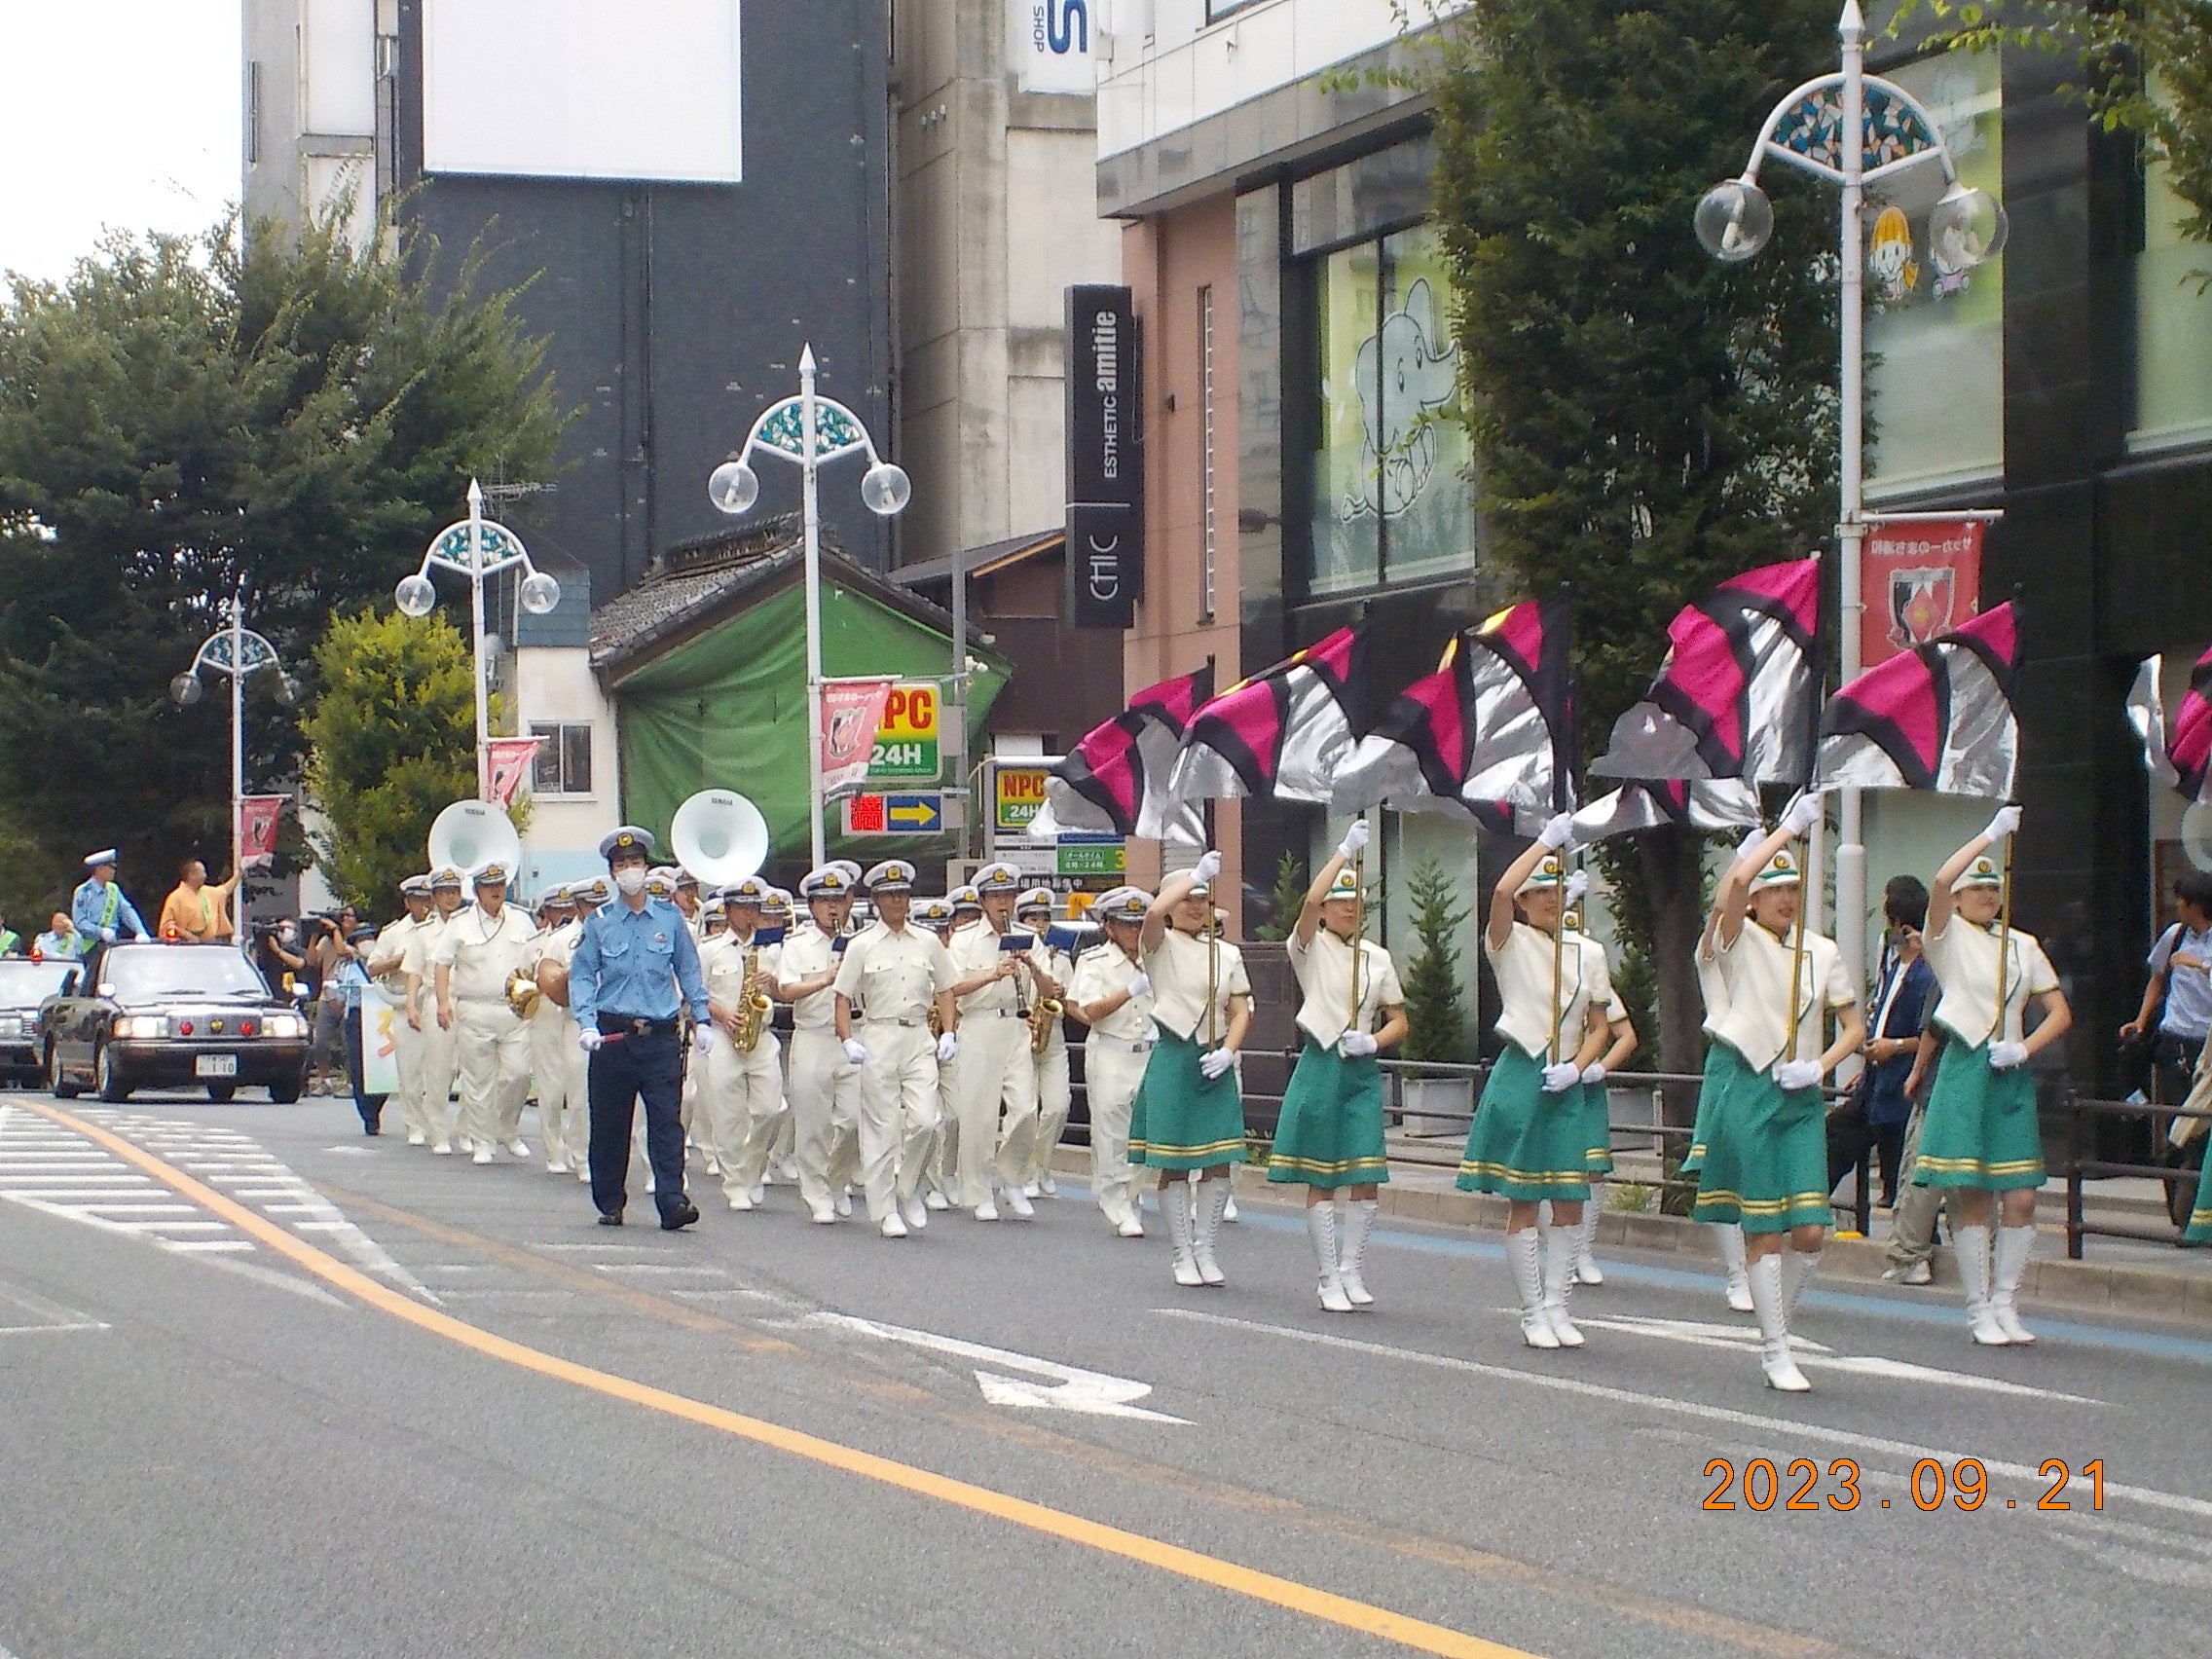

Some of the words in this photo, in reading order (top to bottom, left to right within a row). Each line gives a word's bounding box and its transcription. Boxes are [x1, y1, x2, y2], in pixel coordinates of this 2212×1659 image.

[1033, 6, 1045, 53] SHOP
[1104, 395, 1118, 478] ESTHETIC
[1089, 535, 1119, 601] CHIC
[884, 689, 932, 729] PC
[870, 744, 922, 766] 24H
[1004, 775, 1045, 797] NPC
